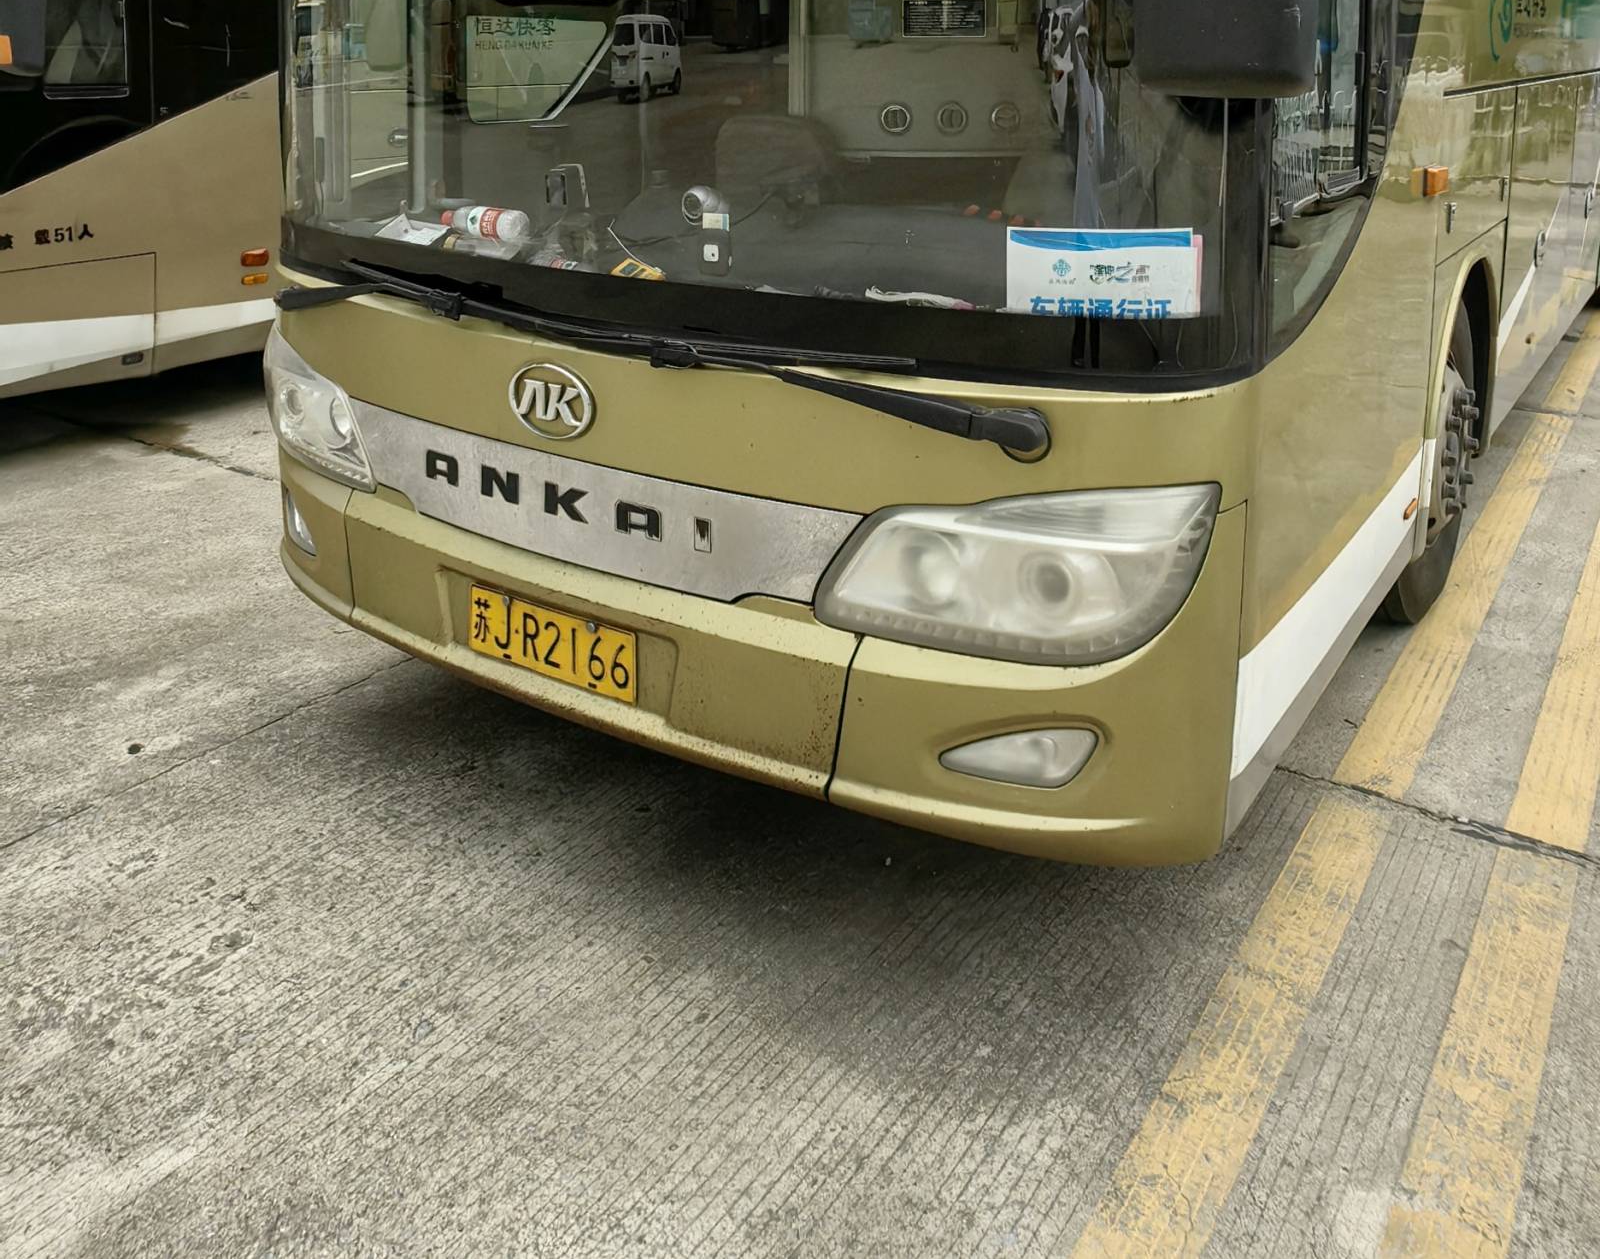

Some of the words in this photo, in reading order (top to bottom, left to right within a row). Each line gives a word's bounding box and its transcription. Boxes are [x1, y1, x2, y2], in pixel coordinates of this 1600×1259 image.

[1030, 295, 1172, 319] 车辆通行证
